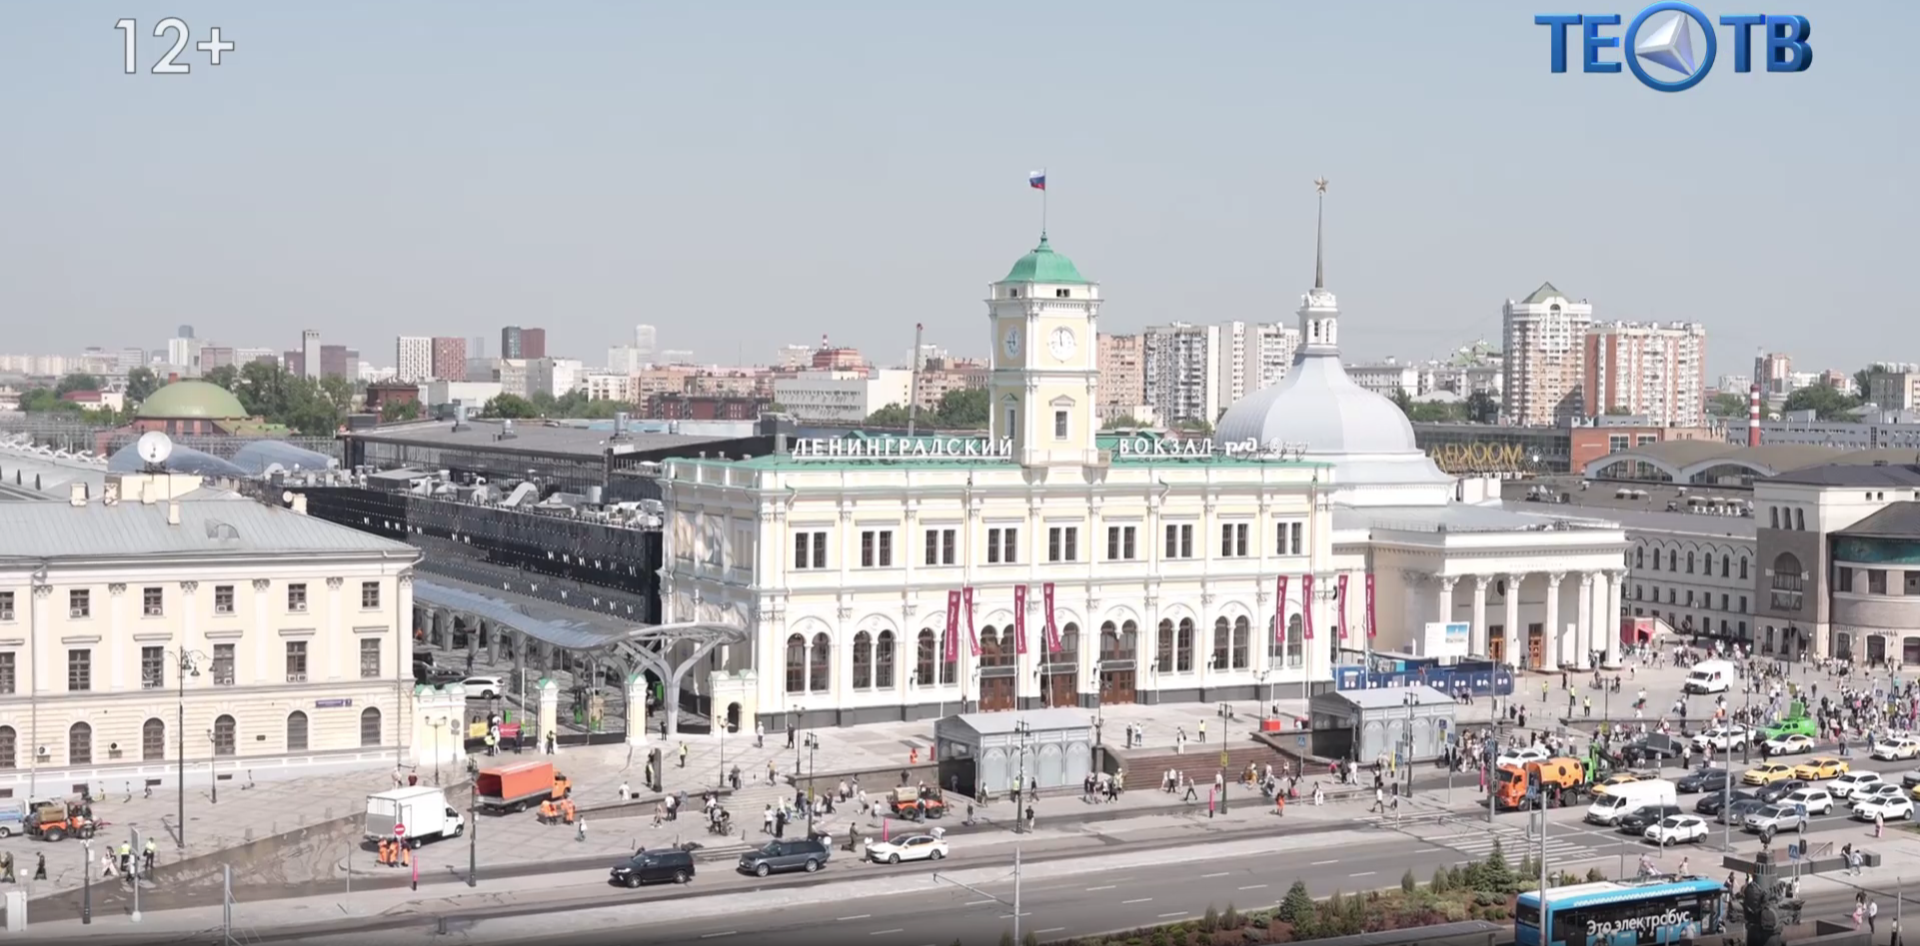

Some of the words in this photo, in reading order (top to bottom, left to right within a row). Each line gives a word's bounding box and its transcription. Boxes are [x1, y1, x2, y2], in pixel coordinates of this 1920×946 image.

[792, 436, 1013, 457] ЛЕНИНГРАДСКИЙ
[1120, 438, 1212, 456] ВОКЗАЛ
[1587, 920, 1612, 936] Это
